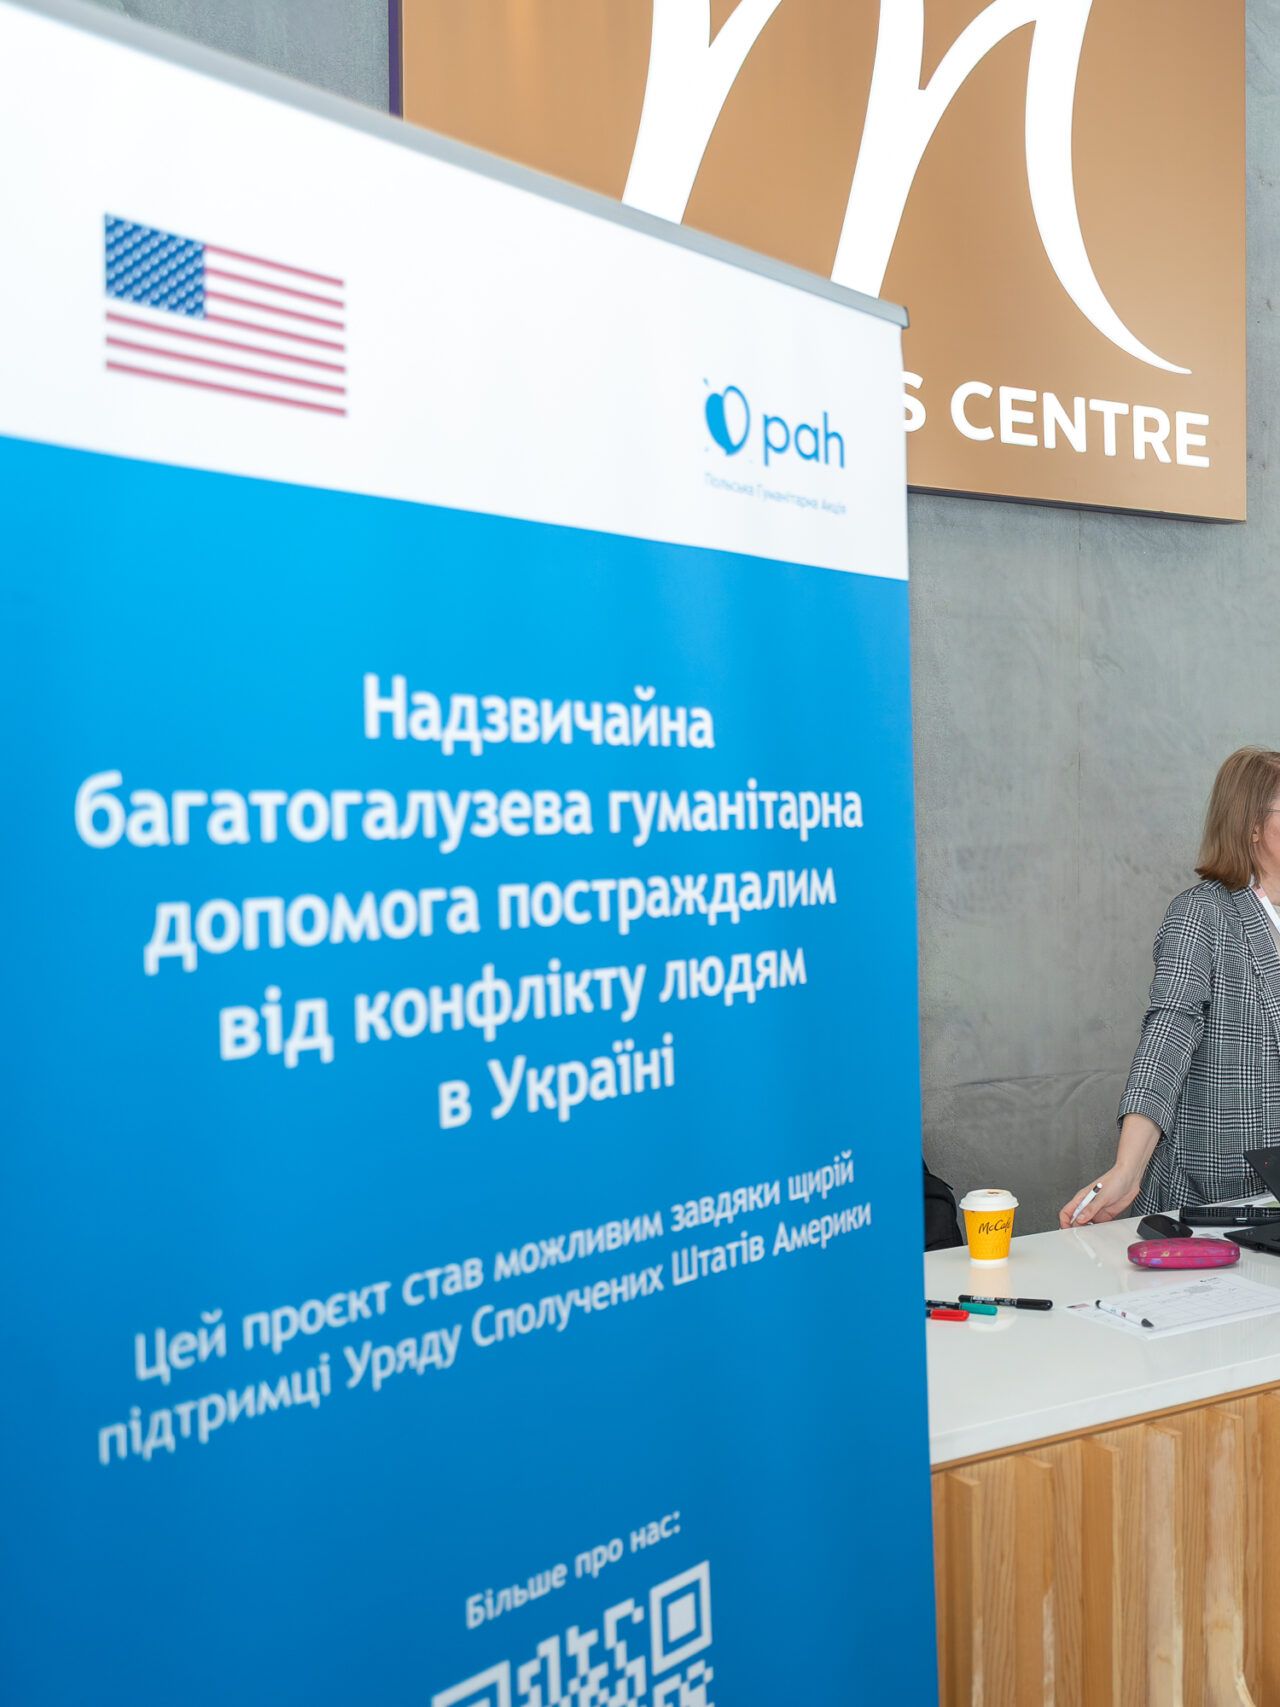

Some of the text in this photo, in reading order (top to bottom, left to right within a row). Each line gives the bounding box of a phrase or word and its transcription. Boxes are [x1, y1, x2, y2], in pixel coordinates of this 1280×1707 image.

[762, 410, 845, 469] pah
[950, 380, 1210, 468] CENTRE
[363, 672, 716, 757] Надзвичайна
[74, 770, 864, 854] багатогалузева гуманітарна
[143, 867, 837, 976] допомога постраждалим
[219, 947, 807, 1069] від конфлікту людям
[438, 1032, 675, 1130] в Україні
[135, 1149, 854, 1384] Цей проєкт став можливим завдяки щирій
[99, 1203, 872, 1464] підтримці Уряду Сполучених Штатів Америки
[466, 1511, 681, 1629] Більше про нас:
